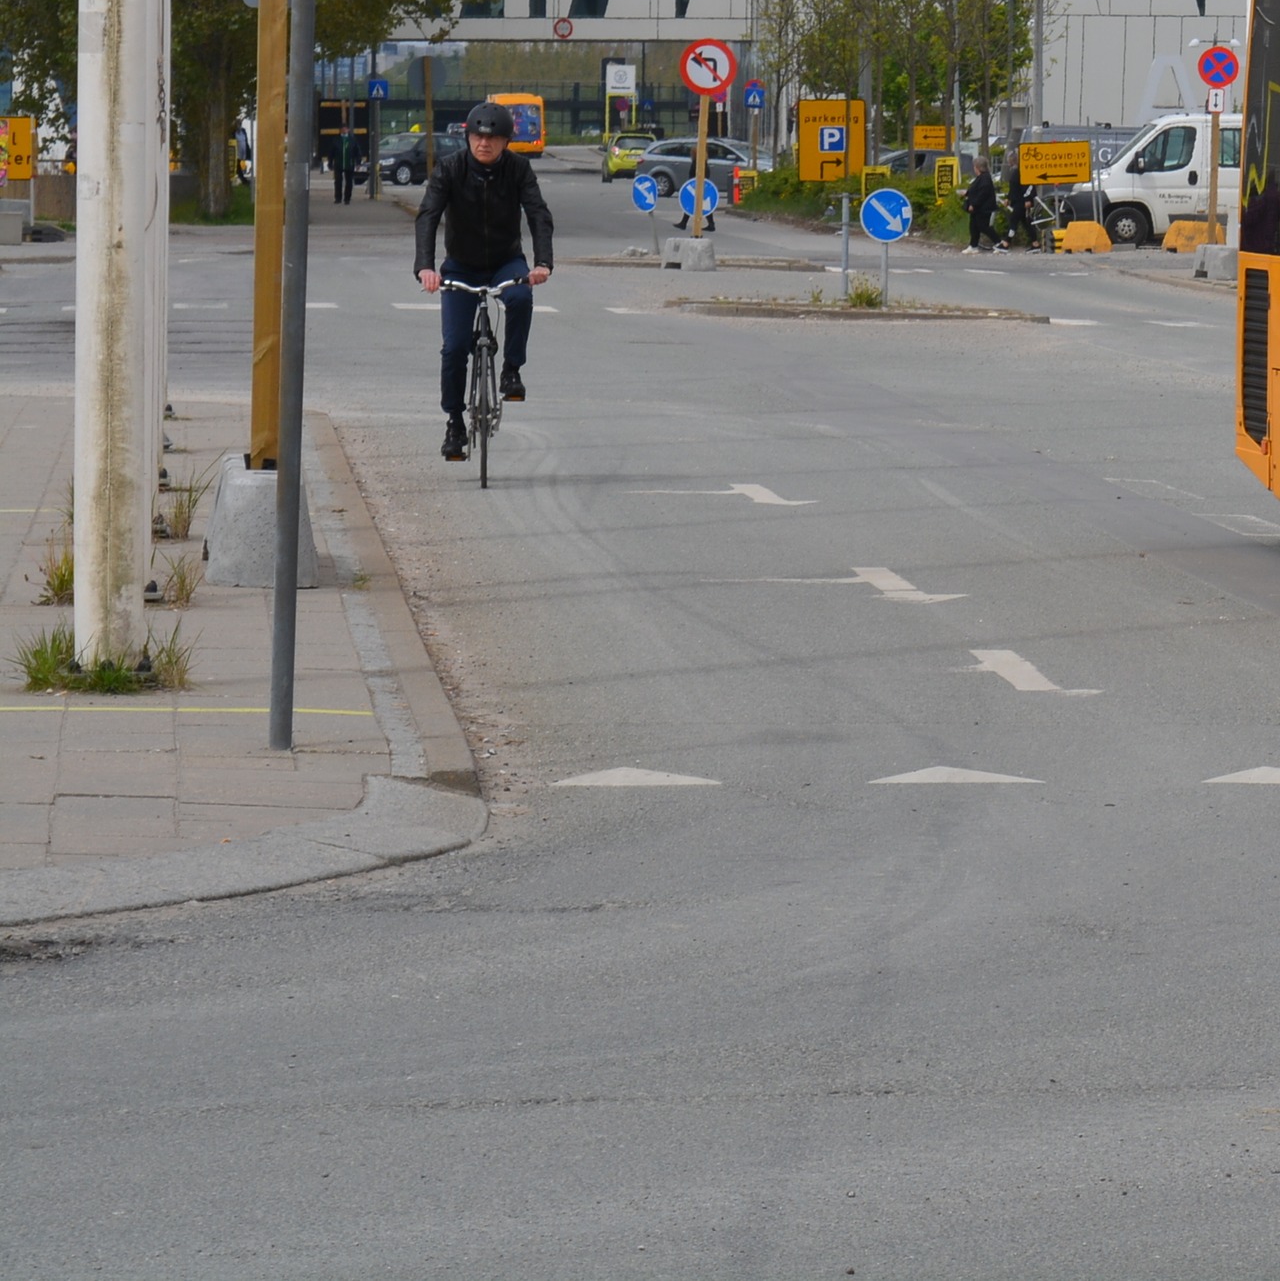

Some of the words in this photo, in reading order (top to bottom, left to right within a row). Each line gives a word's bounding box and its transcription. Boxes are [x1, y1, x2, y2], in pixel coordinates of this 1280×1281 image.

[804, 114, 859, 124] parkerig
[823, 128, 841, 150] P
[1044, 152, 1086, 161] COVID-19
[1024, 161, 1087, 170] vaccinecenter
